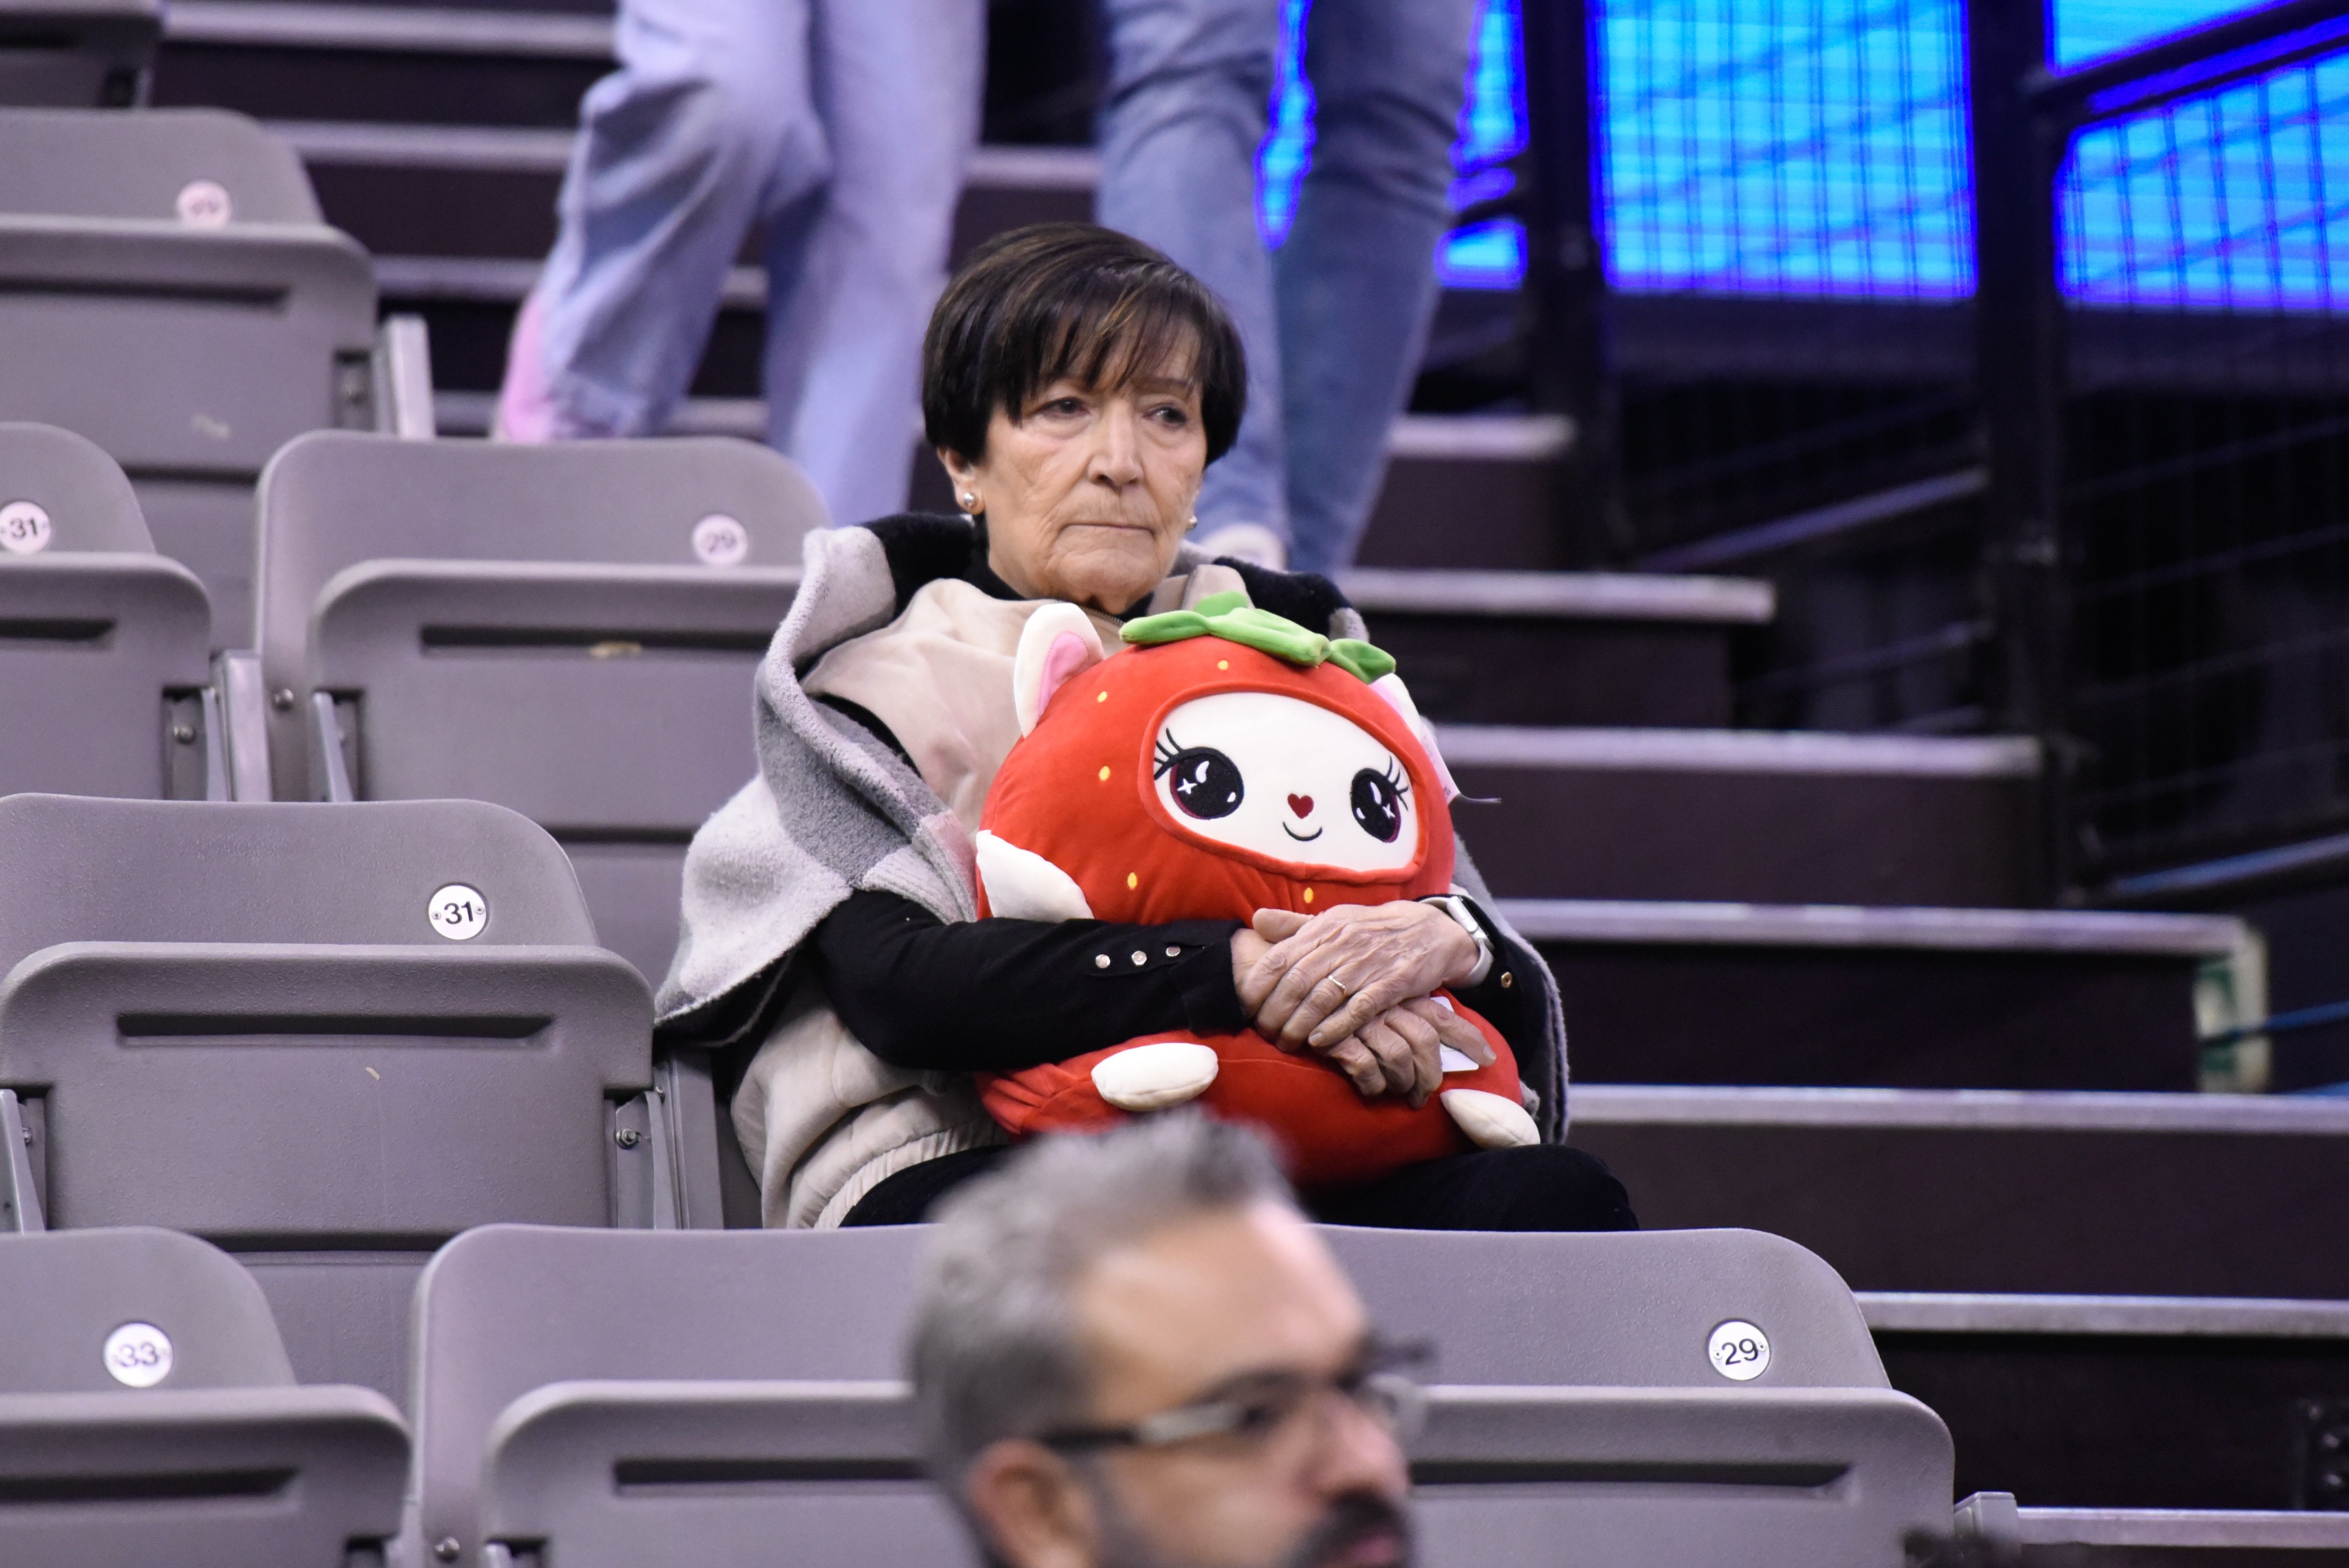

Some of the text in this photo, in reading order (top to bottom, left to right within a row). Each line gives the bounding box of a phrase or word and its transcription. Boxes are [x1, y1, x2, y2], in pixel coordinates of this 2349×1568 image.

[10, 517, 37, 540] 31
[444, 901, 474, 925] 31
[119, 1342, 158, 1367] 33
[1721, 1338, 1758, 1365] 29
